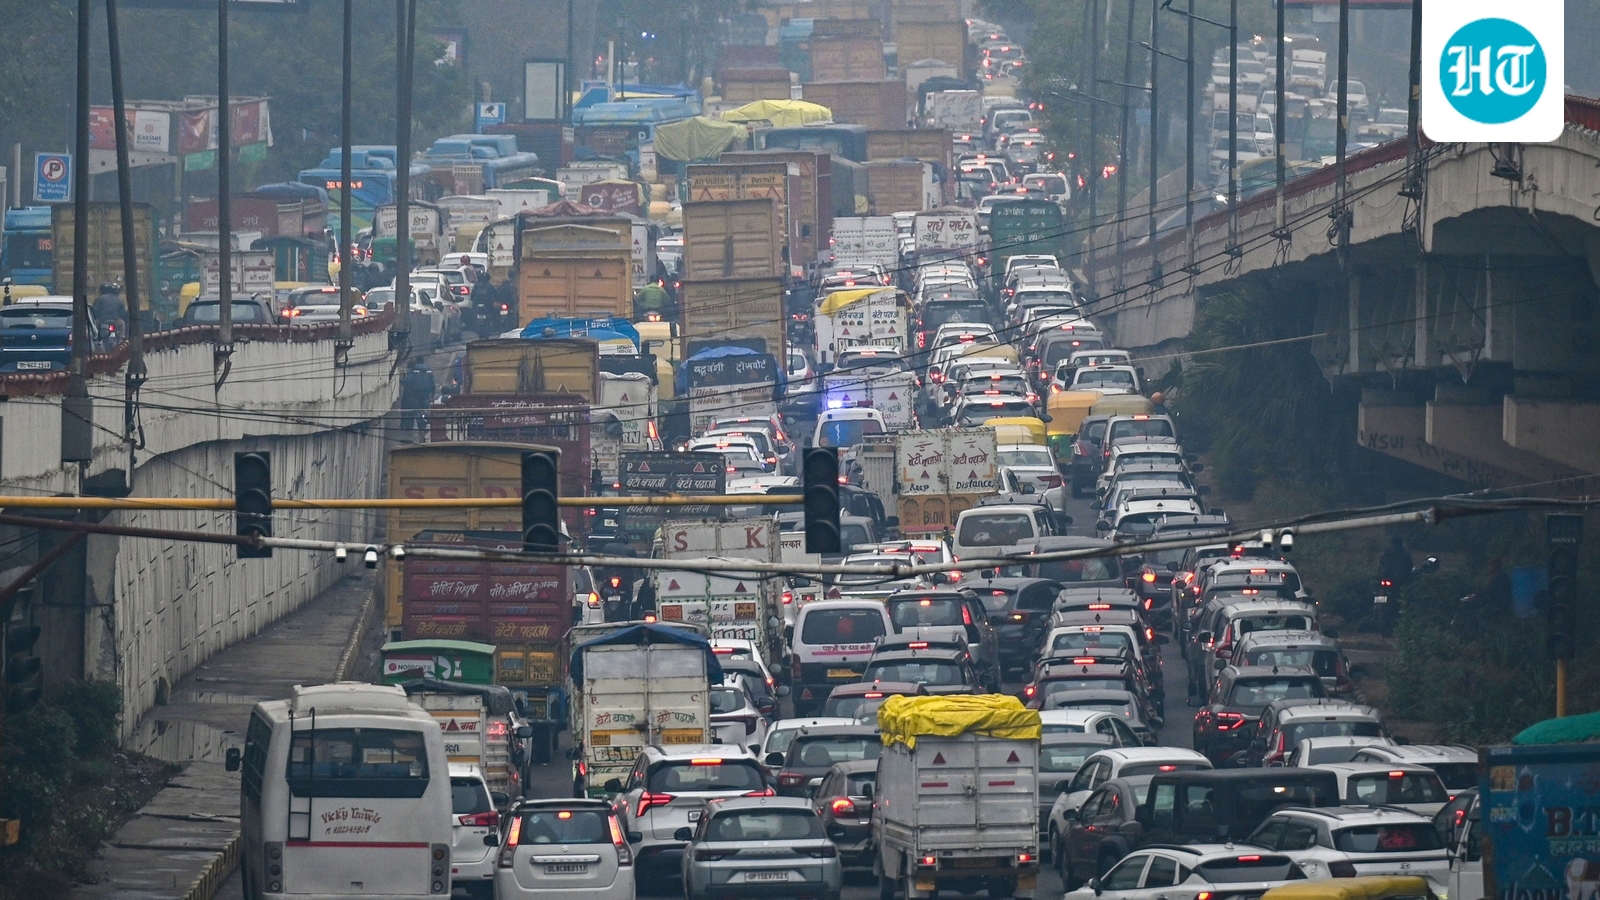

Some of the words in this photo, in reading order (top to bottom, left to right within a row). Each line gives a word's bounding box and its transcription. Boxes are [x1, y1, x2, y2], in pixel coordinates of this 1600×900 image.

[751, 176, 776, 184] Permit
[927, 218, 945, 232] राधे
[949, 217, 968, 232] राधे
[909, 483, 930, 492] Keep
[956, 479, 994, 490] Distance
[923, 511, 945, 525] BLOW
[674, 530, 688, 551] S
[744, 526, 765, 548] K
[495, 622, 518, 638] बेटी
[714, 628, 756, 640] HORN
[321, 807, 348, 824] Vicky
[351, 807, 382, 824] Travels
